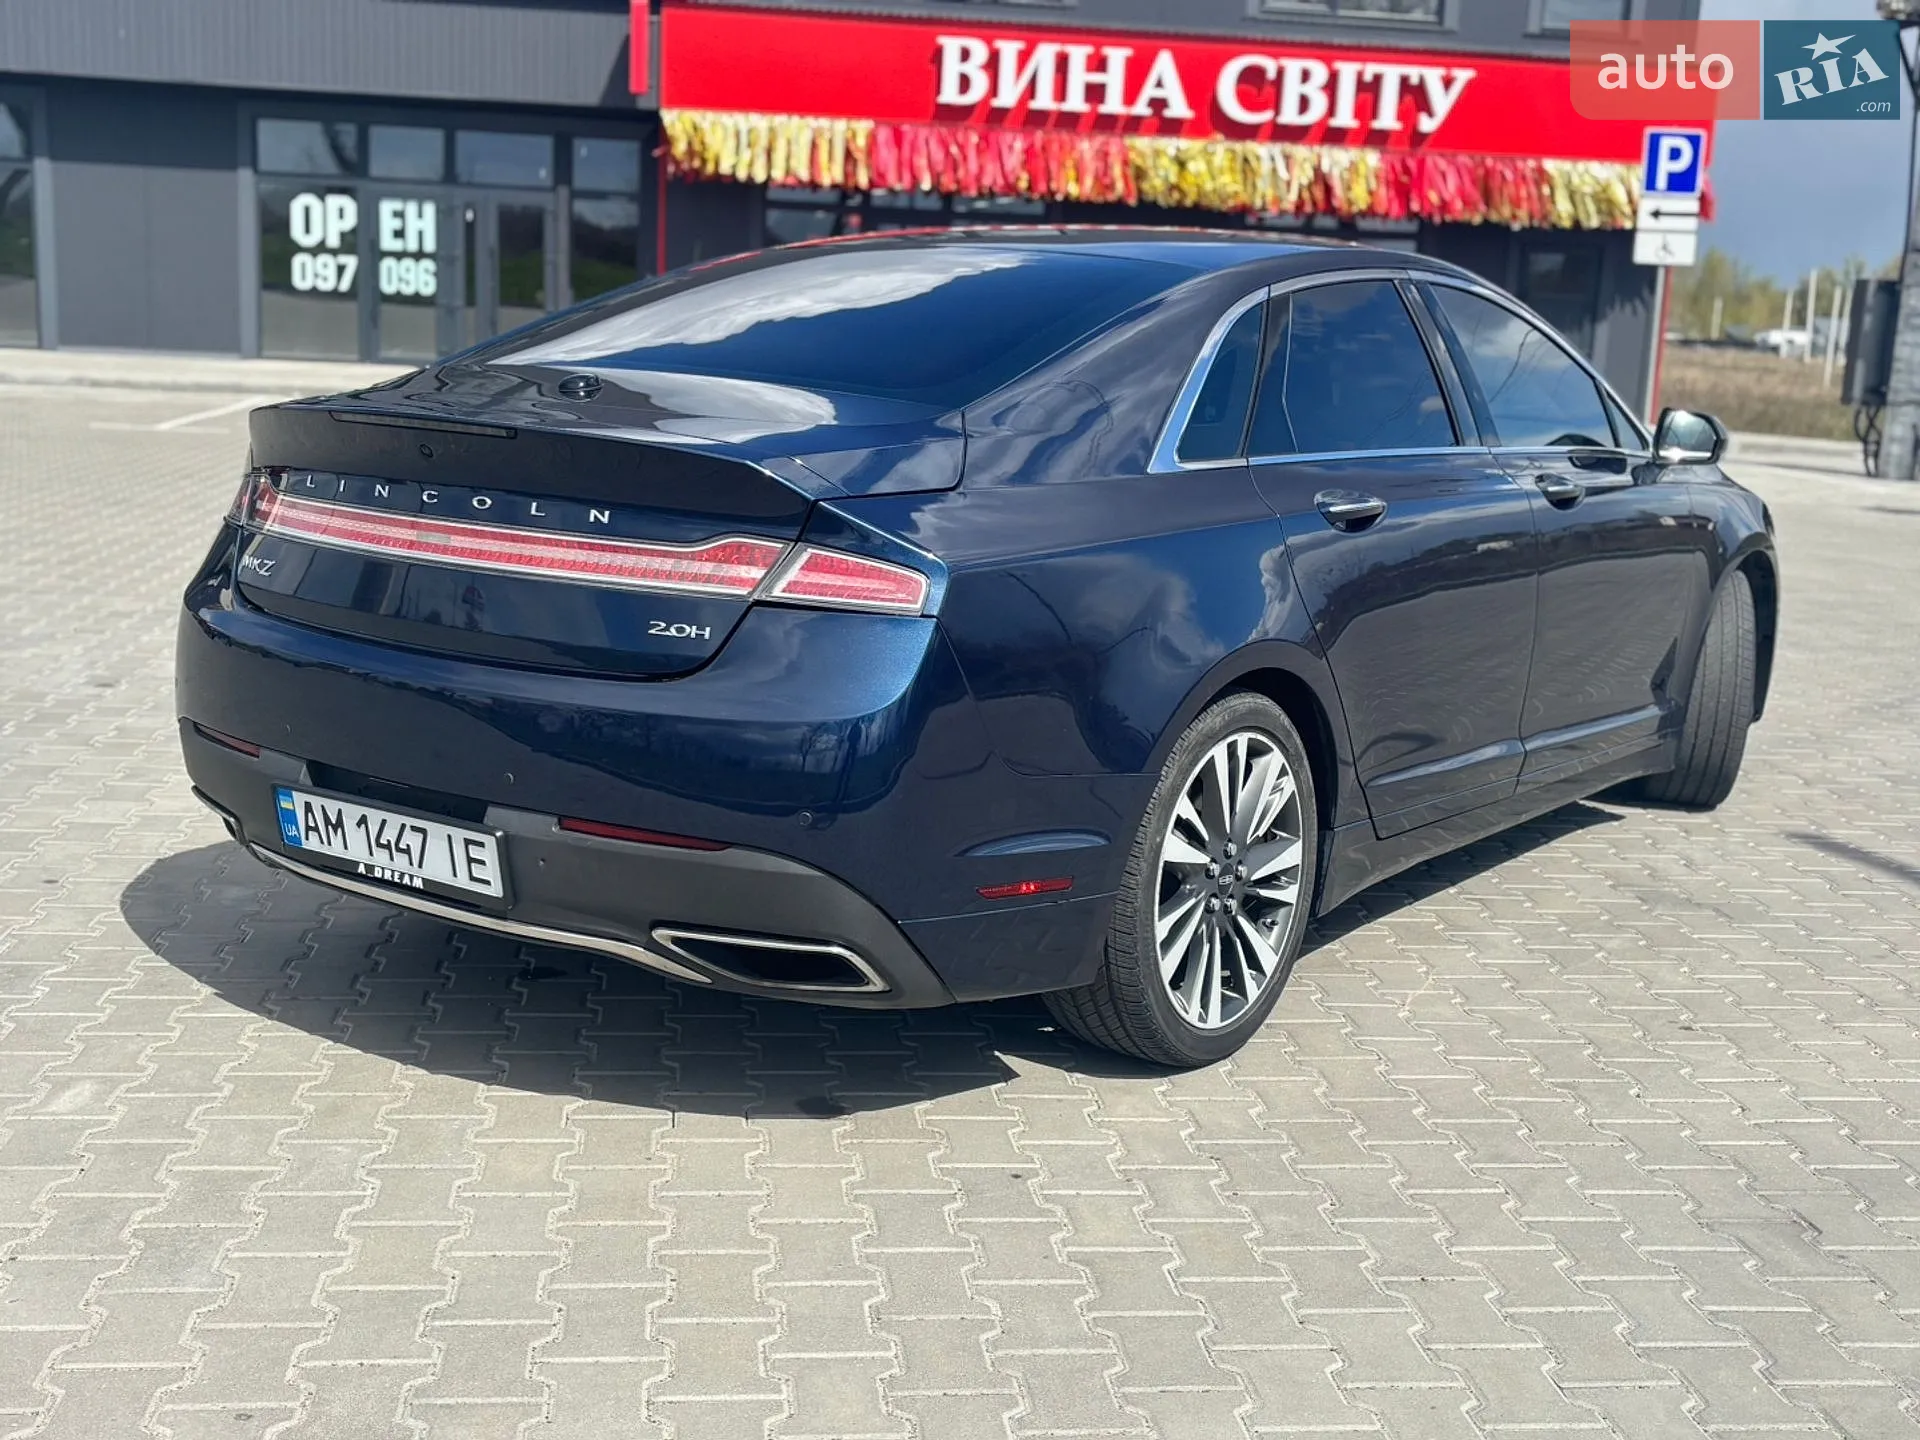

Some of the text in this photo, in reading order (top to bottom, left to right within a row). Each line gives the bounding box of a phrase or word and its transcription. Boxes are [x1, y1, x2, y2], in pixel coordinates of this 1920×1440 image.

[935, 34, 1477, 133] ВИНА СВІТУ
[1654, 135, 1694, 192] P
[290, 252, 438, 297] 097 096
[305, 474, 611, 525] LINCOLN
[243, 555, 277, 577] MKZ
[283, 822, 299, 838] UA
[303, 801, 492, 887] AM 1447 IE
